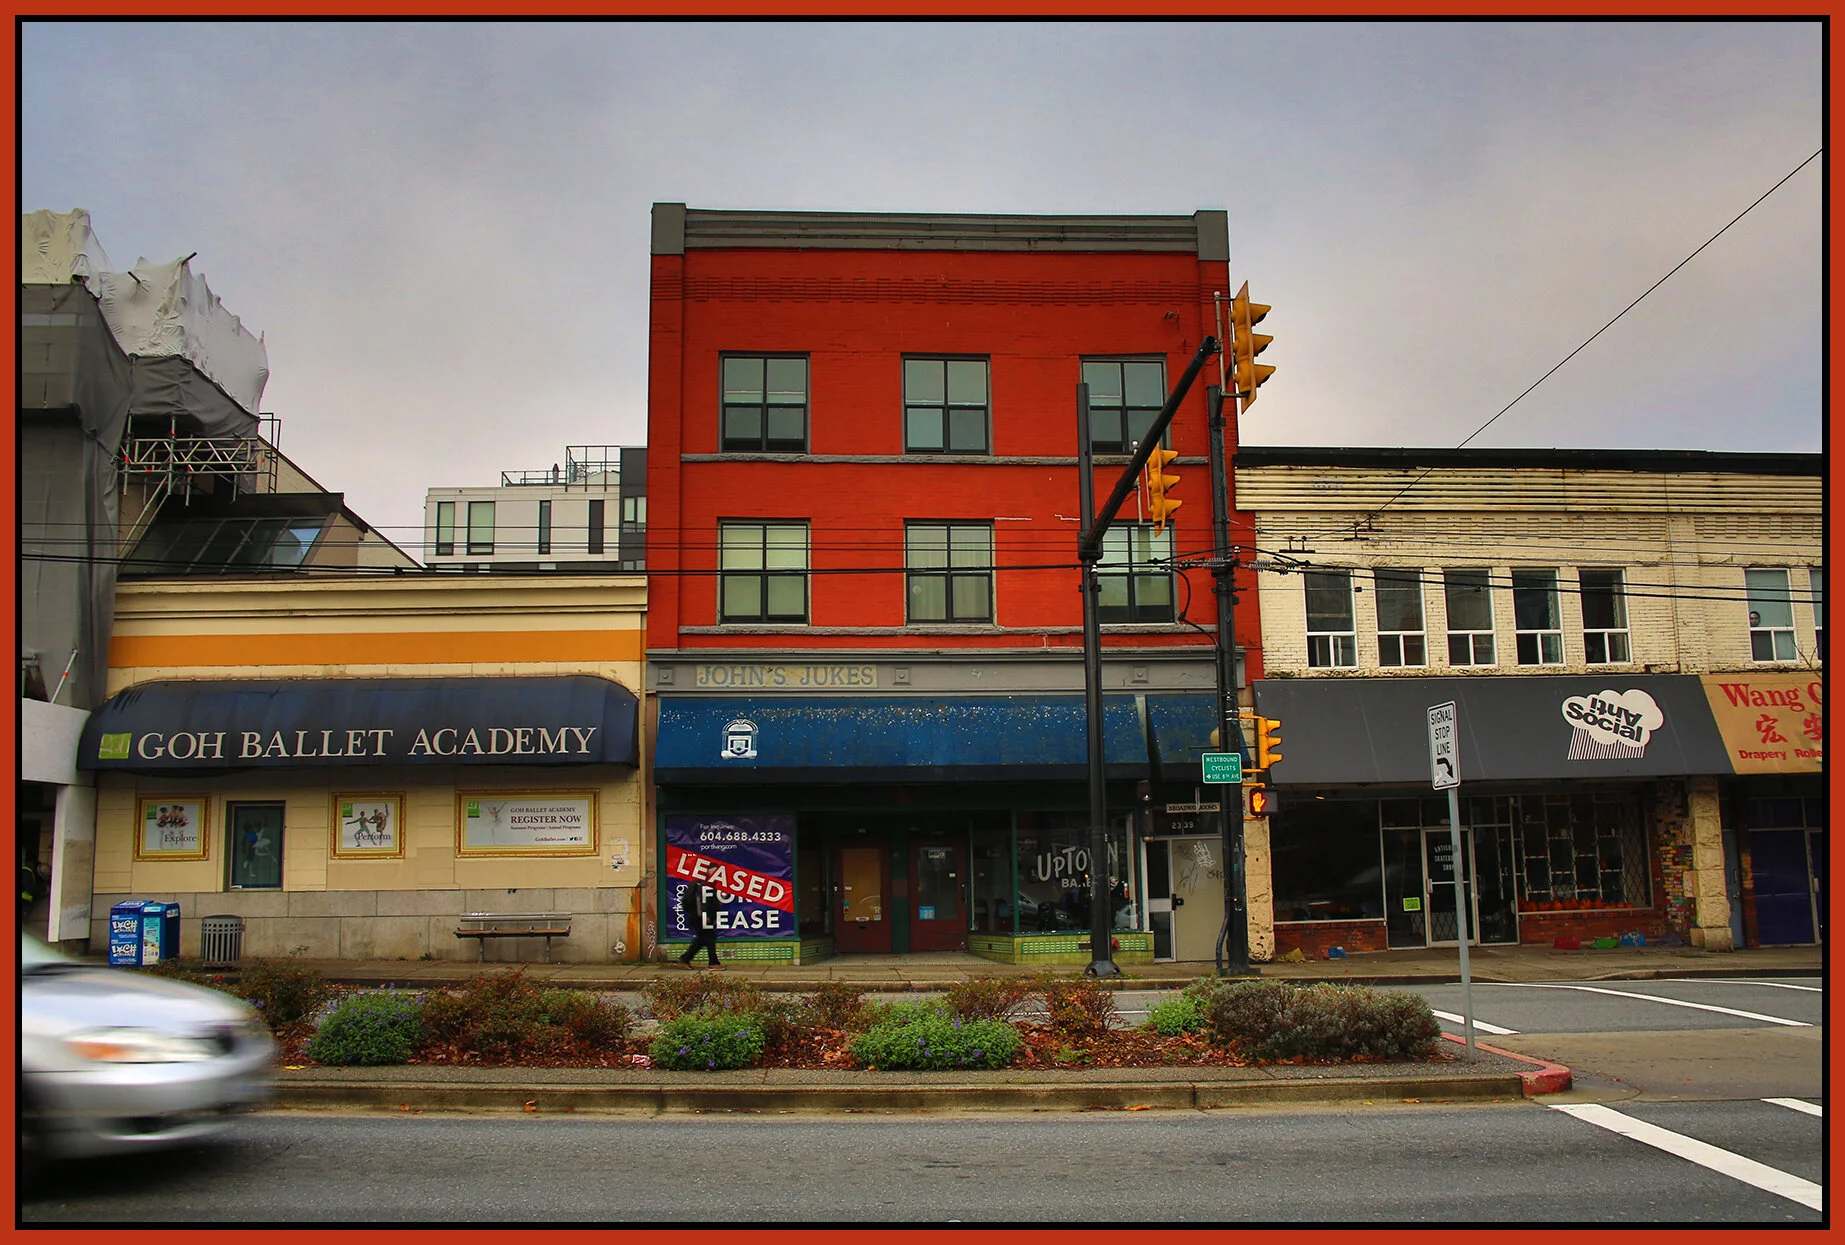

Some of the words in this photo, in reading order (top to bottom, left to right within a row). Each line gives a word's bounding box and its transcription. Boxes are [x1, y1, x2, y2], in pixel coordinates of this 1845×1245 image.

[699, 666, 786, 686] JOHN'S
[800, 666, 874, 686] JUKES
[1718, 683, 1805, 713] Wang
[1430, 709, 1453, 725] SIGNAL
[1589, 697, 1643, 727] Anti
[1566, 702, 1643, 742] Social
[1434, 726, 1450, 740] STOP
[137, 732, 226, 760] GOH
[238, 730, 394, 758] BALLET
[407, 727, 598, 756] ACADEMY
[1436, 742, 1451, 756] LINE
[1738, 750, 1787, 761] Drapery
[510, 815, 557, 824] REGISTER
[559, 815, 582, 823] NOW
[164, 834, 197, 845] Explore
[358, 831, 391, 841] Perform
[700, 831, 782, 842] 604.688.4333
[676, 853, 785, 902] LEASED
[702, 910, 780, 930] LEASE
